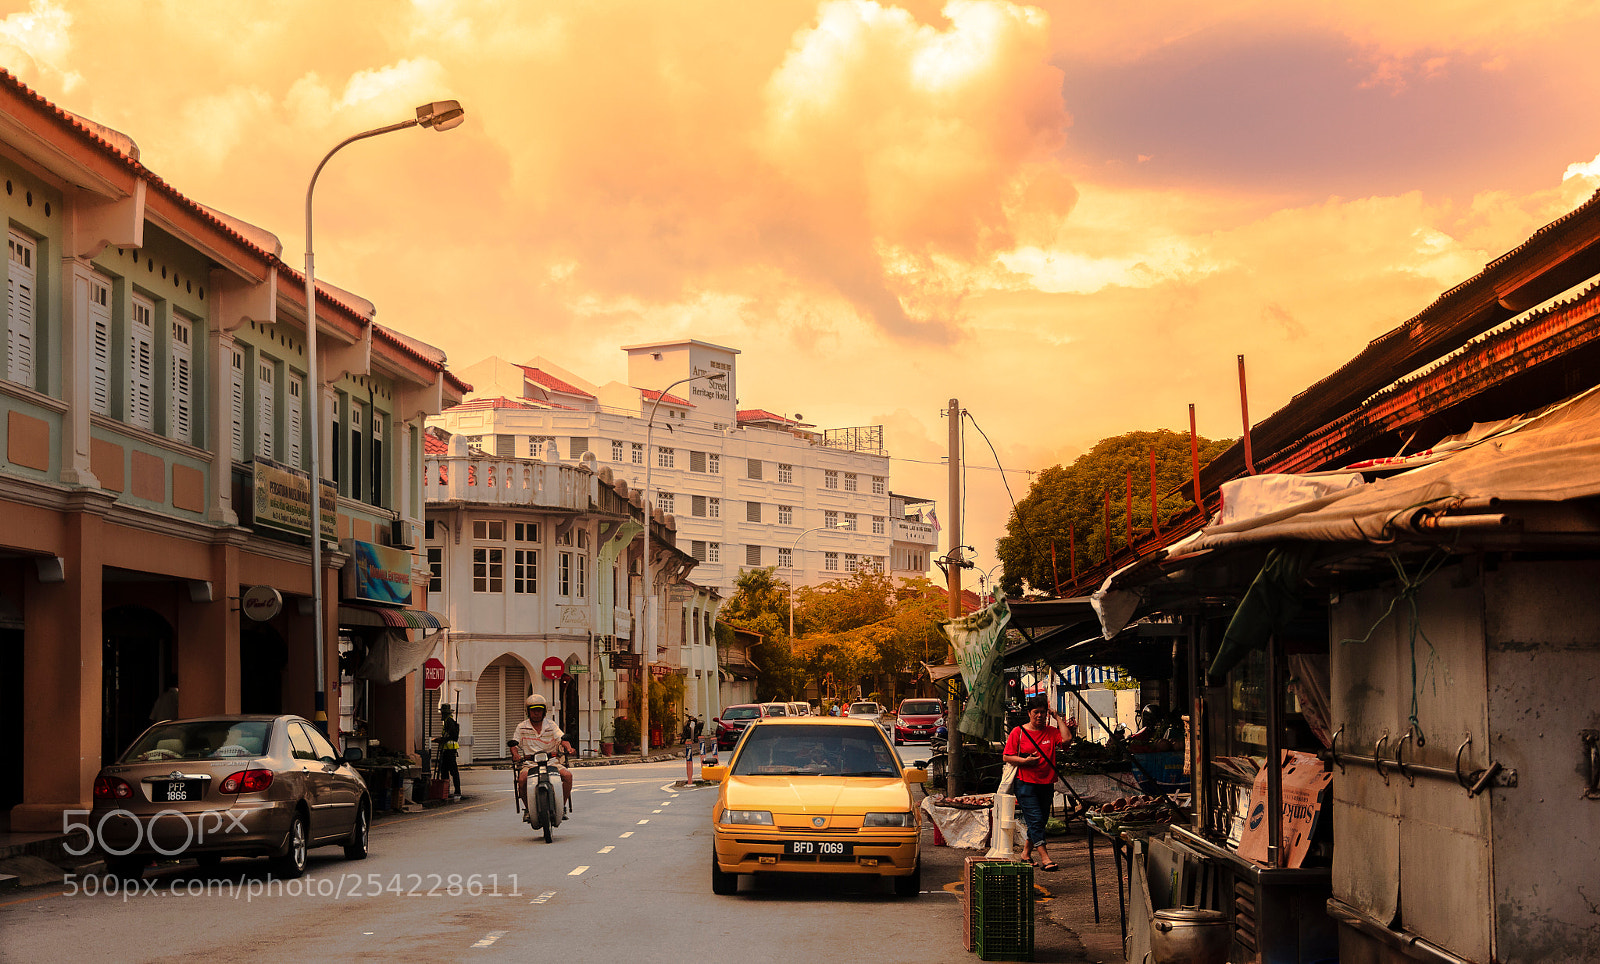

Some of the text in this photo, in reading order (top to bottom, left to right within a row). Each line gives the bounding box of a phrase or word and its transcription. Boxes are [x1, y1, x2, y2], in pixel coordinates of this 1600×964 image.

[709, 380, 728, 391] Street
[692, 387, 715, 400] Heritage
[425, 667, 445, 680] RHENTI
[168, 782, 186, 791] PFP
[166, 791, 187, 801] 1866
[793, 841, 844, 855] BFD 7069
